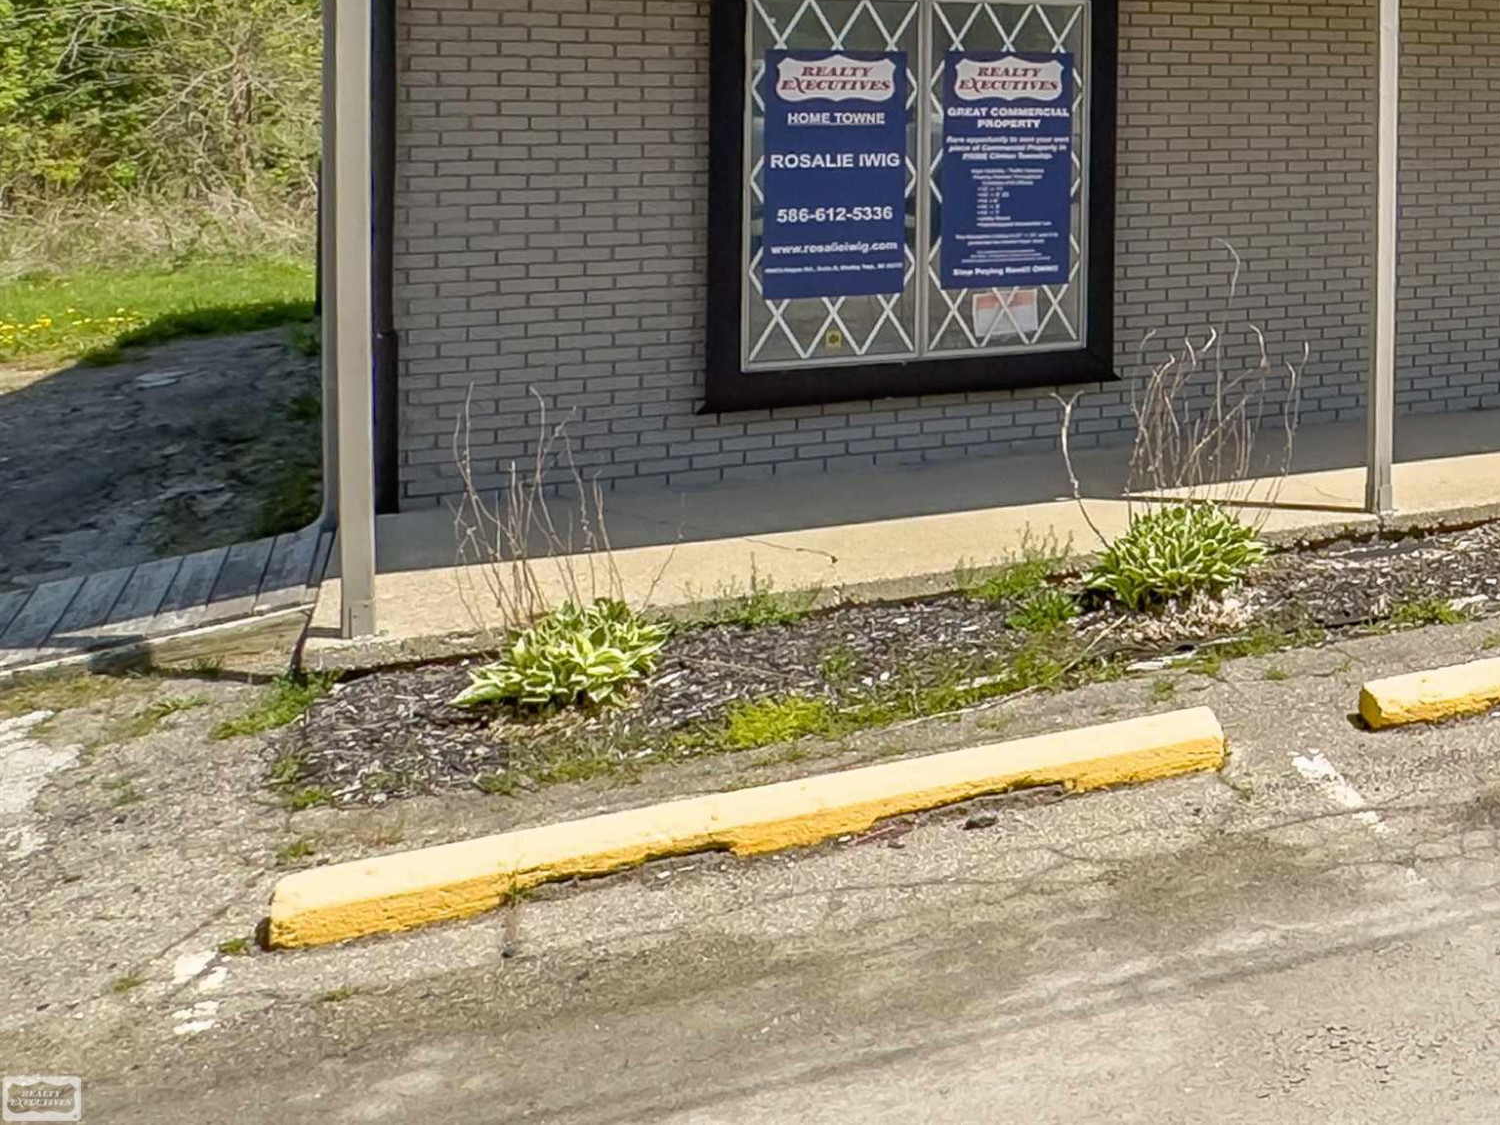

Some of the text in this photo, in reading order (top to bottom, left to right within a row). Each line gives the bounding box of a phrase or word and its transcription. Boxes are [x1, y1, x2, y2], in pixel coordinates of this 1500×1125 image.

[801, 66, 874, 76] REALTY
[977, 66, 1042, 76] REALTY
[780, 76, 891, 94] EXECUTIVES
[958, 77, 1058, 93] EXECUTIVES
[787, 112, 885, 125] HOME TOWNE
[947, 107, 1070, 117] GREAT COMMERCIAL
[977, 119, 1041, 128] PROPERTY
[770, 153, 900, 168] ROSALIE IWIG
[776, 206, 893, 223] 586-612-5336
